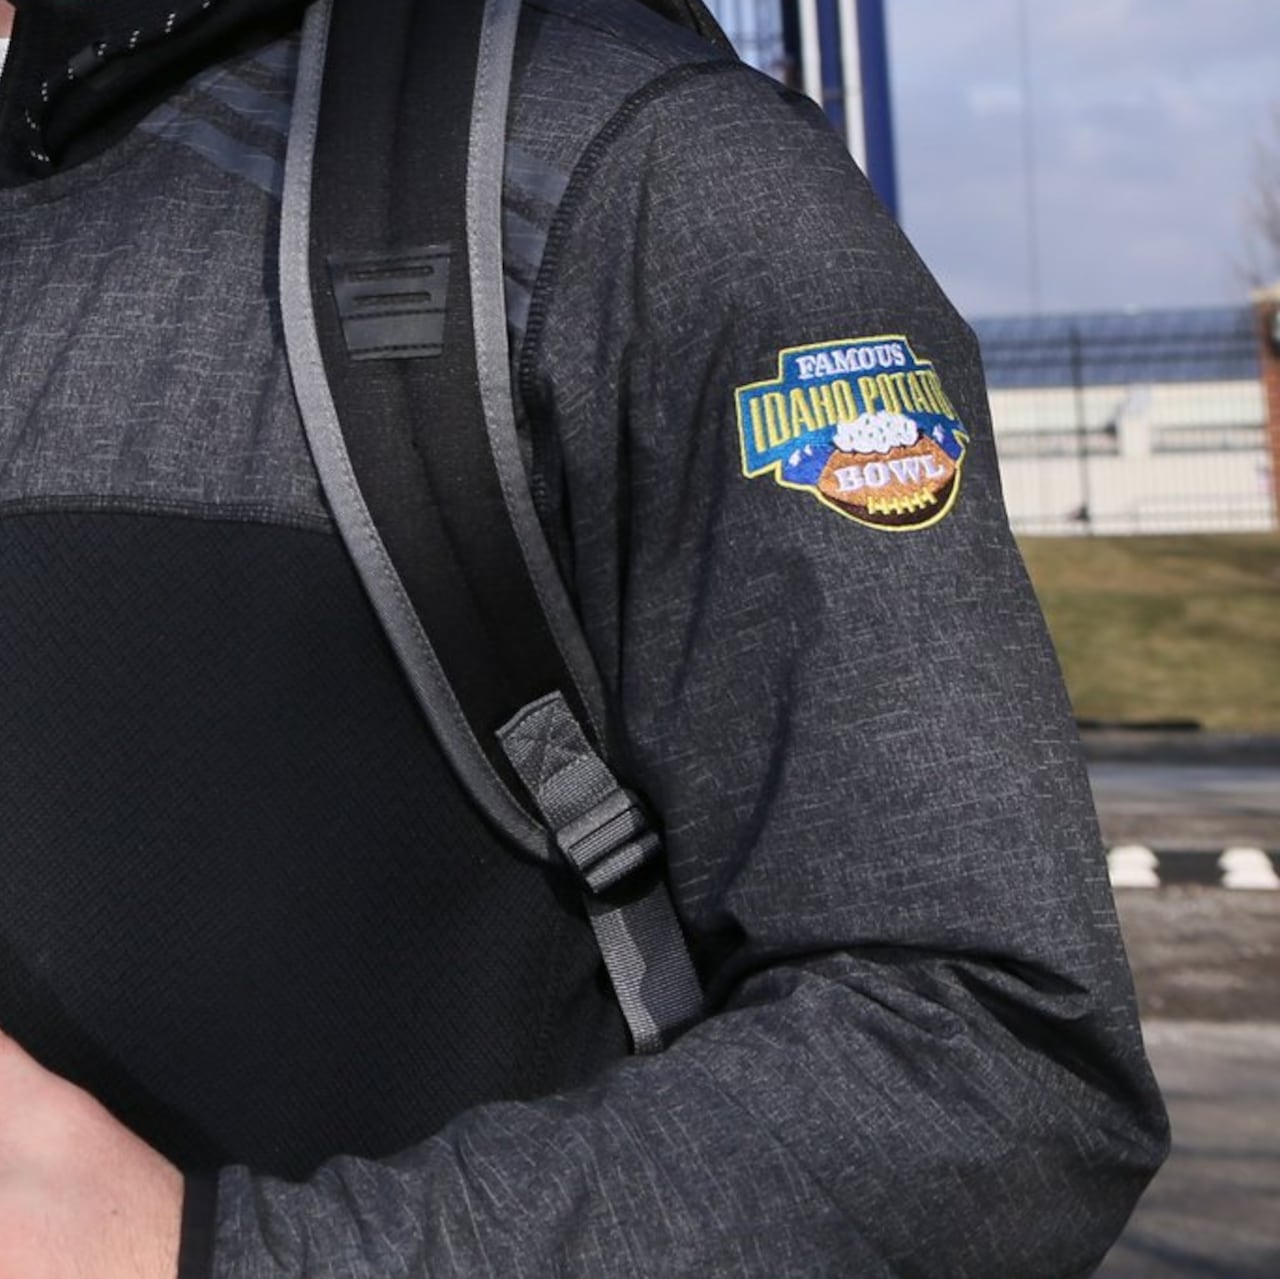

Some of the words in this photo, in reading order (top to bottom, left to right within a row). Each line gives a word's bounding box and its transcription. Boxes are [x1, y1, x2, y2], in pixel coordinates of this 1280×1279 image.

[796, 343, 907, 380] FAMOUS
[749, 379, 858, 454] IDAHO
[834, 454, 947, 492] BOWL
